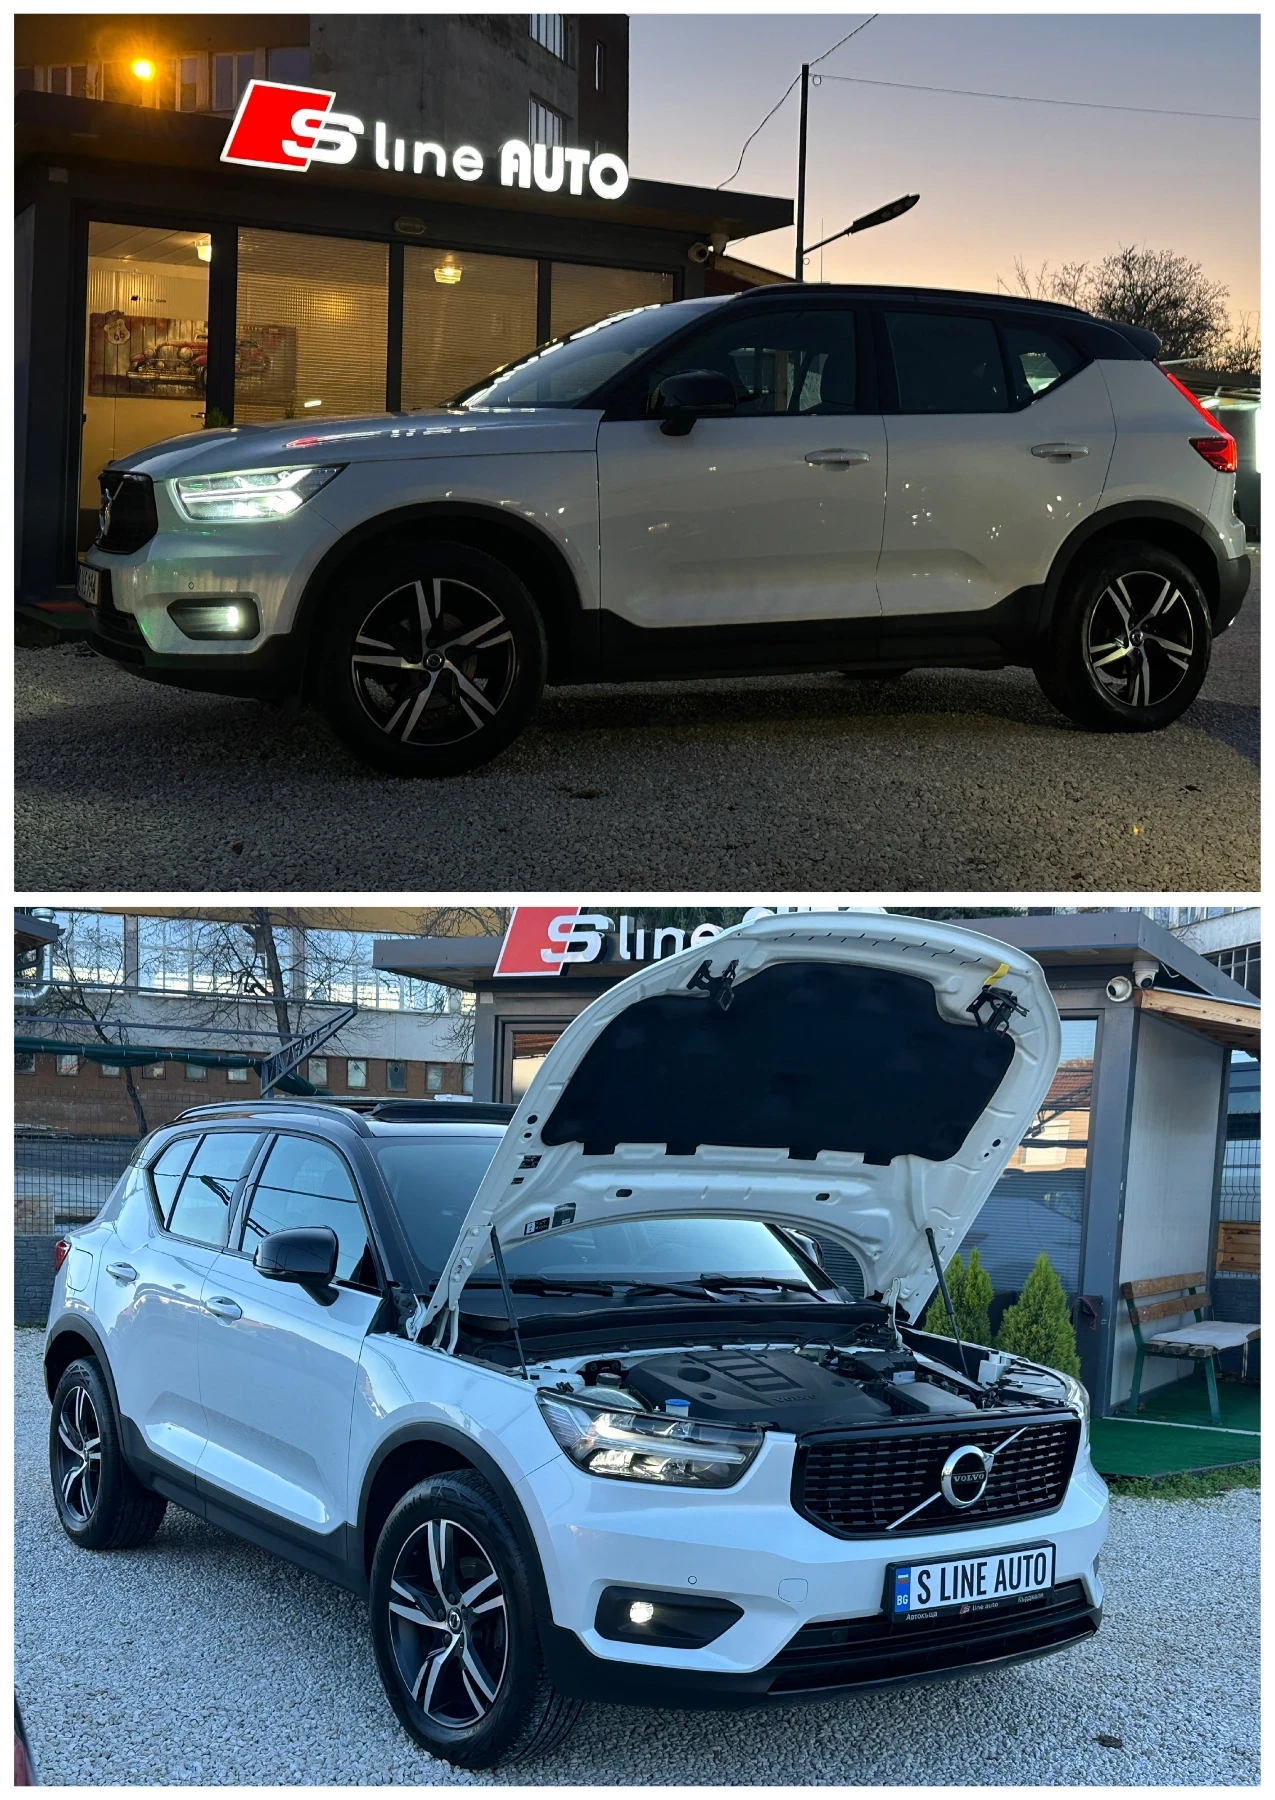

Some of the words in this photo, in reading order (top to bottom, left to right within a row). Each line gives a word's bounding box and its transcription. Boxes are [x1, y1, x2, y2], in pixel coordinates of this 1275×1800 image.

[281, 108, 364, 165] S
[375, 121, 484, 181] line
[500, 139, 630, 200] AUTO
[541, 914, 615, 963] S
[953, 1473, 985, 1482] VOLVO
[896, 1594, 909, 1606] BG
[917, 1569, 931, 1605] S
[939, 1561, 988, 1602] LINE
[993, 1552, 1047, 1593] AUTO
